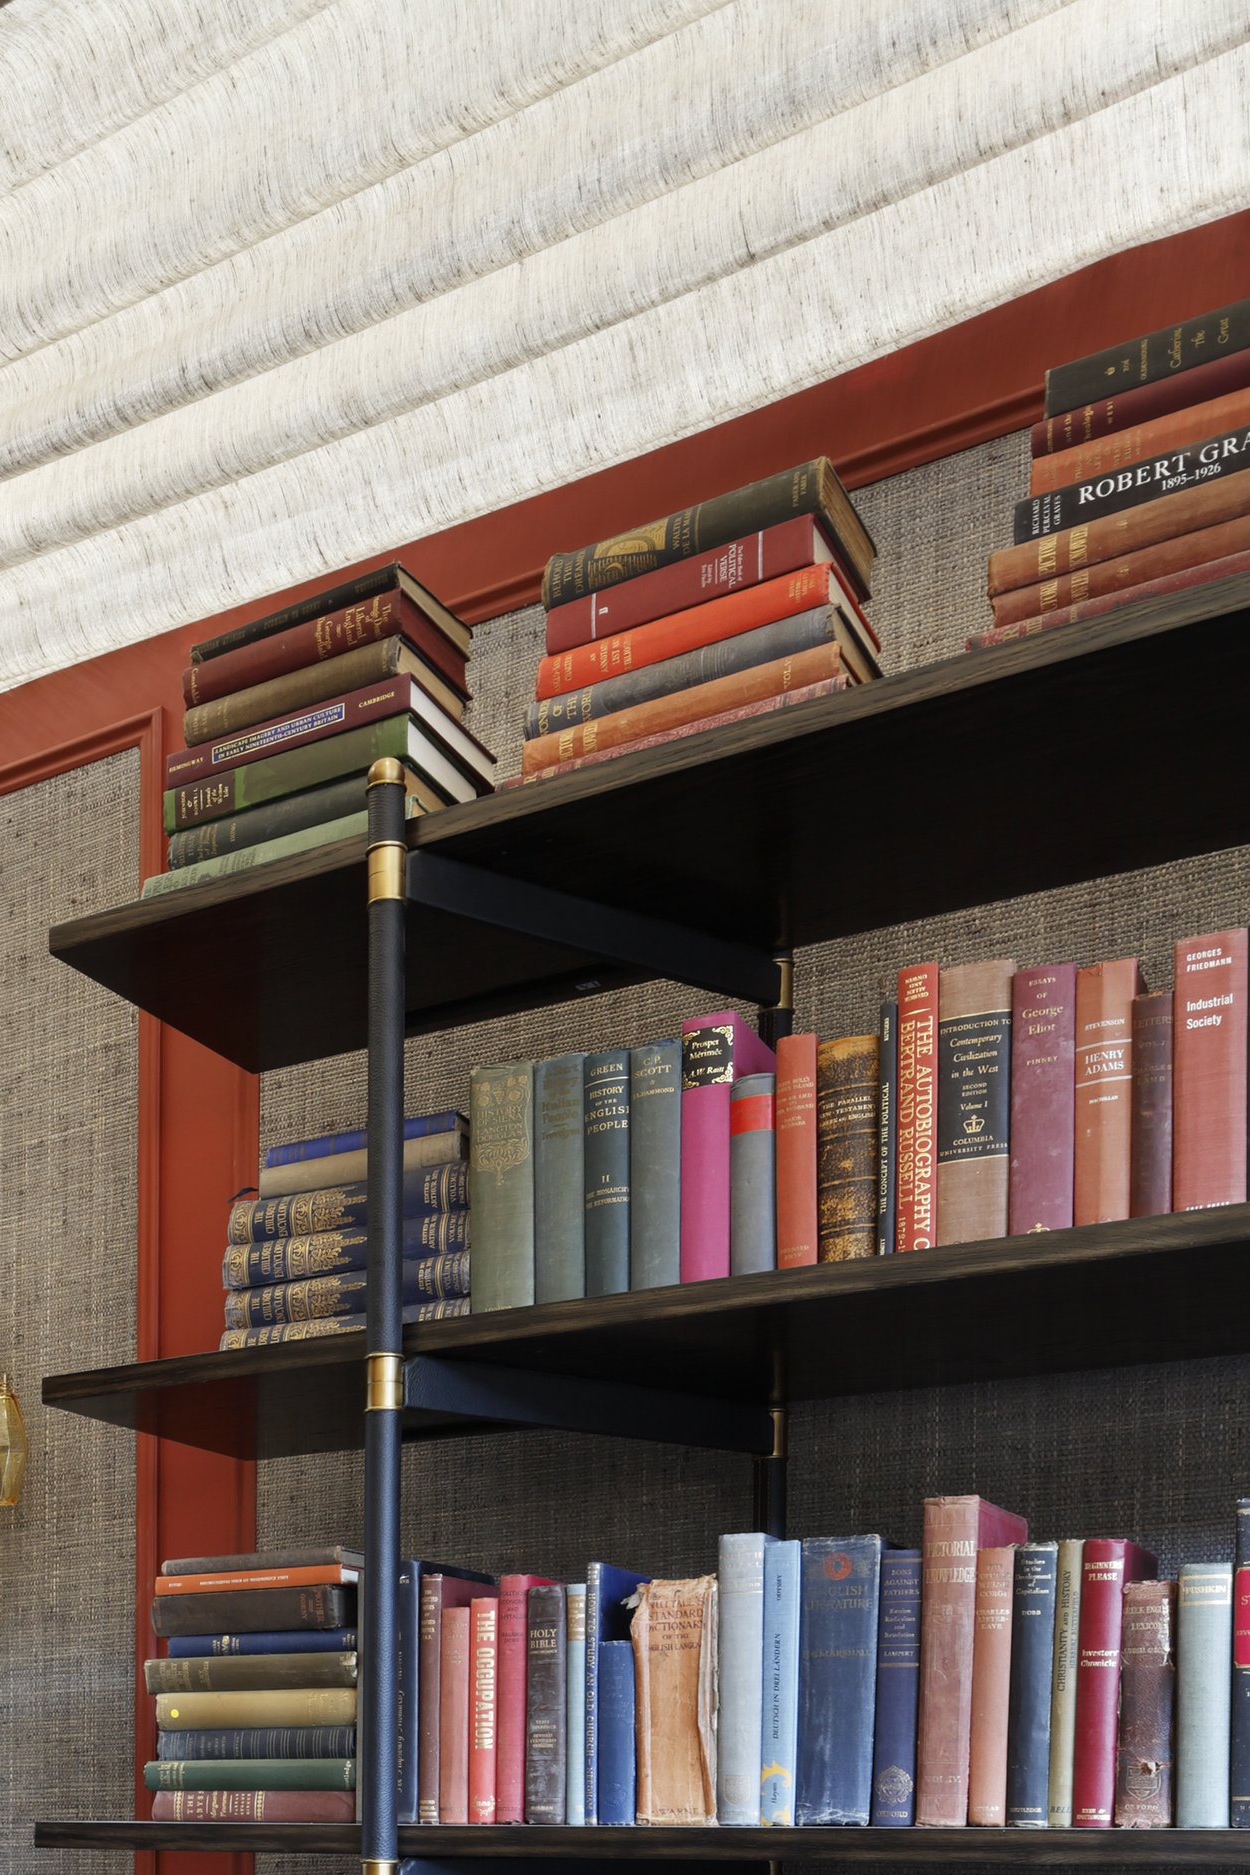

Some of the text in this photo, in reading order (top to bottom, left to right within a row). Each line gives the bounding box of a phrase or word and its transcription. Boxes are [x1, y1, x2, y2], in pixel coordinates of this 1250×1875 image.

[1078, 452, 1190, 505] ROBERT
[1032, 499, 1040, 535] RICHARD
[1054, 494, 1062, 527] GRAVES
[719, 554, 728, 583] VERSE
[729, 544, 737, 589] POLITICAL
[344, 608, 357, 646] England
[354, 606, 367, 638] Liberal
[358, 691, 396, 708] CAMBRIDGE
[214, 738, 248, 755] LANDSCAPE
[249, 729, 276, 745] IMAGERY
[276, 723, 291, 735] AND
[312, 706, 341, 722] CULTURE
[225, 744, 245, 757] EARLY
[168, 755, 204, 774] HEMINGWAY
[1186, 948, 1222, 961] GEORGES
[1187, 957, 1232, 973] FRIEDMANN
[1028, 976, 1056, 987] ESSAYS
[1036, 992, 1048, 1000] OF
[1186, 993, 1234, 1012] Industrial
[1021, 1006, 1064, 1019] George
[939, 1019, 1000, 1034] INTRODUCTION
[1028, 1022, 1056, 1036] Eliot
[1085, 1018, 1125, 1031] STEVENSON
[1186, 1014, 1223, 1034] Society
[691, 1039, 720, 1051] Prosper
[949, 1033, 1002, 1049] Contemporary
[689, 1048, 724, 1061] Mérimée
[953, 1050, 998, 1063] Civilization
[1085, 1049, 1125, 1064] HENRY
[590, 1063, 623, 1078] GREEN
[634, 1064, 673, 1080] SCOTT
[951, 1064, 999, 1079] in the West
[1085, 1060, 1125, 1076] ADAMS
[589, 1085, 625, 1101] HISTORY
[961, 1081, 988, 1091] SECOND
[961, 1088, 988, 1098] EDITION
[960, 1102, 981, 1112] Volume
[897, 1022, 915, 1210] BERTRAND RUSSELL
[913, 1016, 933, 1232] THE AUTOBIOGRAPHY
[587, 1119, 629, 1136] PEOPLE
[880, 1081, 891, 1214] THE CONCEPT OF THE POLITICAL
[952, 1134, 993, 1147] COLUMBIA
[940, 1142, 1009, 1157] UNIVERSITY PRESS
[926, 1540, 976, 1558] PICTORIAL
[1020, 1558, 1046, 1566] Studies
[1084, 1558, 1124, 1571] BEGINNERS
[884, 1578, 919, 1586] AGAINST
[925, 1567, 977, 1584] KNOWLEDGE
[1088, 1571, 1118, 1581] PLEASE
[884, 1588, 921, 1597] FATHERS
[1015, 1587, 1050, 1597] Capitalism
[1061, 1570, 1071, 1606] HISTORY
[586, 1592, 595, 1615] HOW
[587, 1618, 595, 1632] TO
[894, 1623, 906, 1631] and
[530, 1628, 558, 1639] HOLY
[530, 1638, 557, 1648] BIBLE
[586, 1637, 595, 1668] STUDY
[1058, 1627, 1069, 1691] CHRISTIANITY
[1080, 1658, 1118, 1668] Chronicle
[475, 1610, 496, 1749] THE OCCUPATION
[586, 1672, 595, 1685] AN
[772, 1632, 782, 1740] DEUTSCH IN DREI LÄNDERN
[586, 1690, 595, 1711] OLD
[586, 1716, 594, 1757] CHURCH
[186, 1794, 195, 1814] THE
